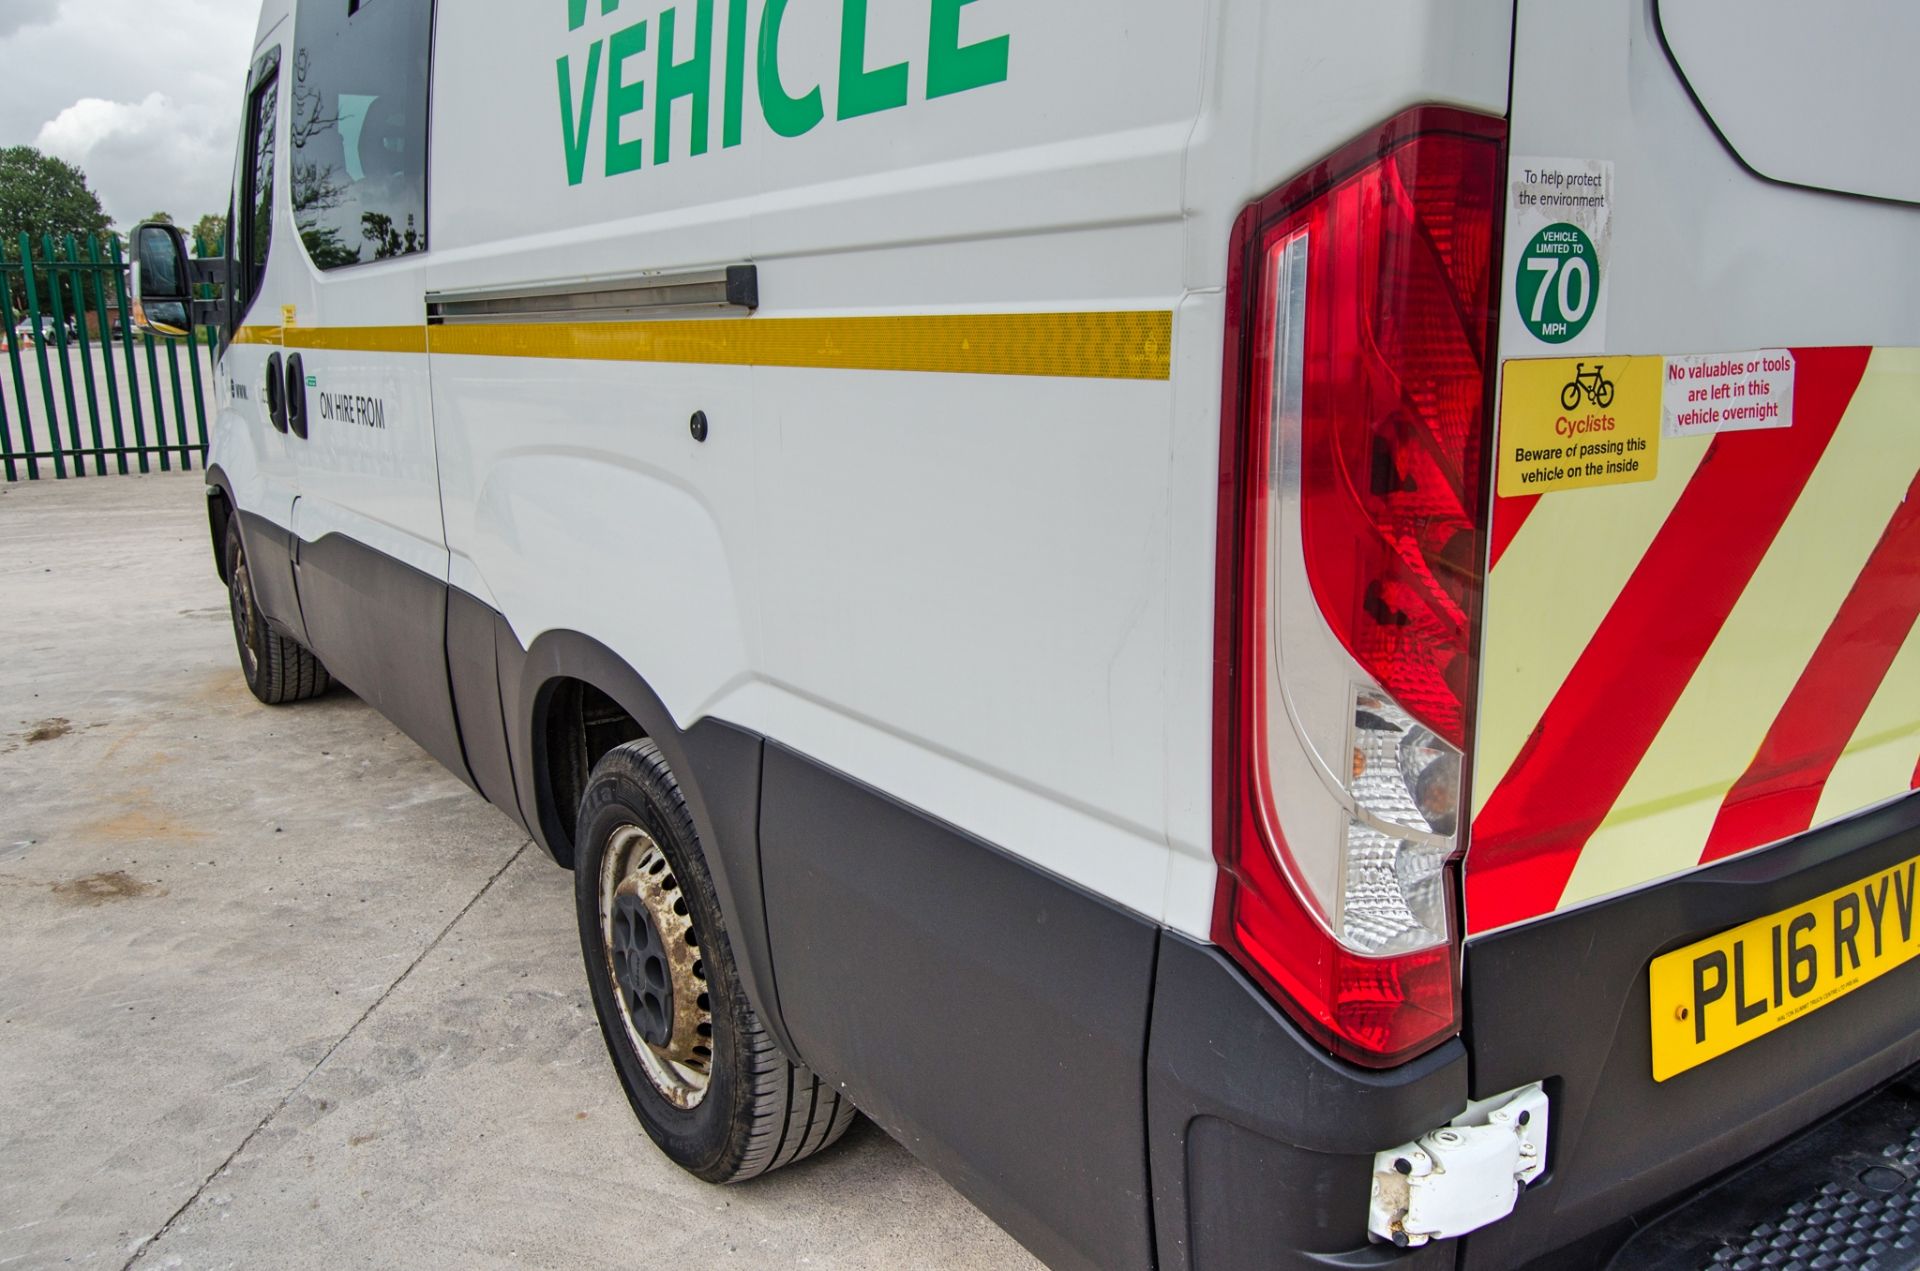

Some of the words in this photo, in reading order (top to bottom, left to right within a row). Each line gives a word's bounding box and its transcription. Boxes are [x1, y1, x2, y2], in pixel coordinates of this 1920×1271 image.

[1524, 169, 1538, 184] To
[1540, 169, 1564, 188] help
[1566, 172, 1602, 190] protect
[1519, 190, 1537, 206] the
[1540, 192, 1604, 208] environment
[1536, 243, 1569, 254] LIMITED
[1572, 243, 1584, 254] TO
[1542, 231, 1578, 243] VEHICLE
[1526, 256, 1590, 323] 70
[1542, 323, 1567, 336] MPH
[1668, 364, 1685, 380] No
[1688, 360, 1744, 379] valuables
[1746, 361, 1760, 373] or
[1763, 355, 1791, 372] tools
[1688, 388, 1708, 402] are
[1710, 383, 1731, 400] left
[1733, 382, 1745, 397] in
[1748, 379, 1770, 395] this
[320, 391, 335, 420] ON
[335, 392, 355, 424] HIRE
[356, 396, 386, 430] FROM
[1677, 407, 1720, 426] vehicle
[1722, 402, 1779, 423] overnight
[1555, 414, 1615, 438] Cyclists
[1515, 447, 1563, 462] Beware
[1565, 443, 1579, 458] of
[1579, 440, 1624, 459] passing
[1626, 438, 1647, 453] this
[1521, 465, 1564, 483] vehicle
[1566, 466, 1583, 479] on
[1584, 460, 1604, 476] the
[1605, 458, 1639, 474] inside
[1693, 912, 1817, 1045] PL16
[1833, 862, 1916, 979] RYV
